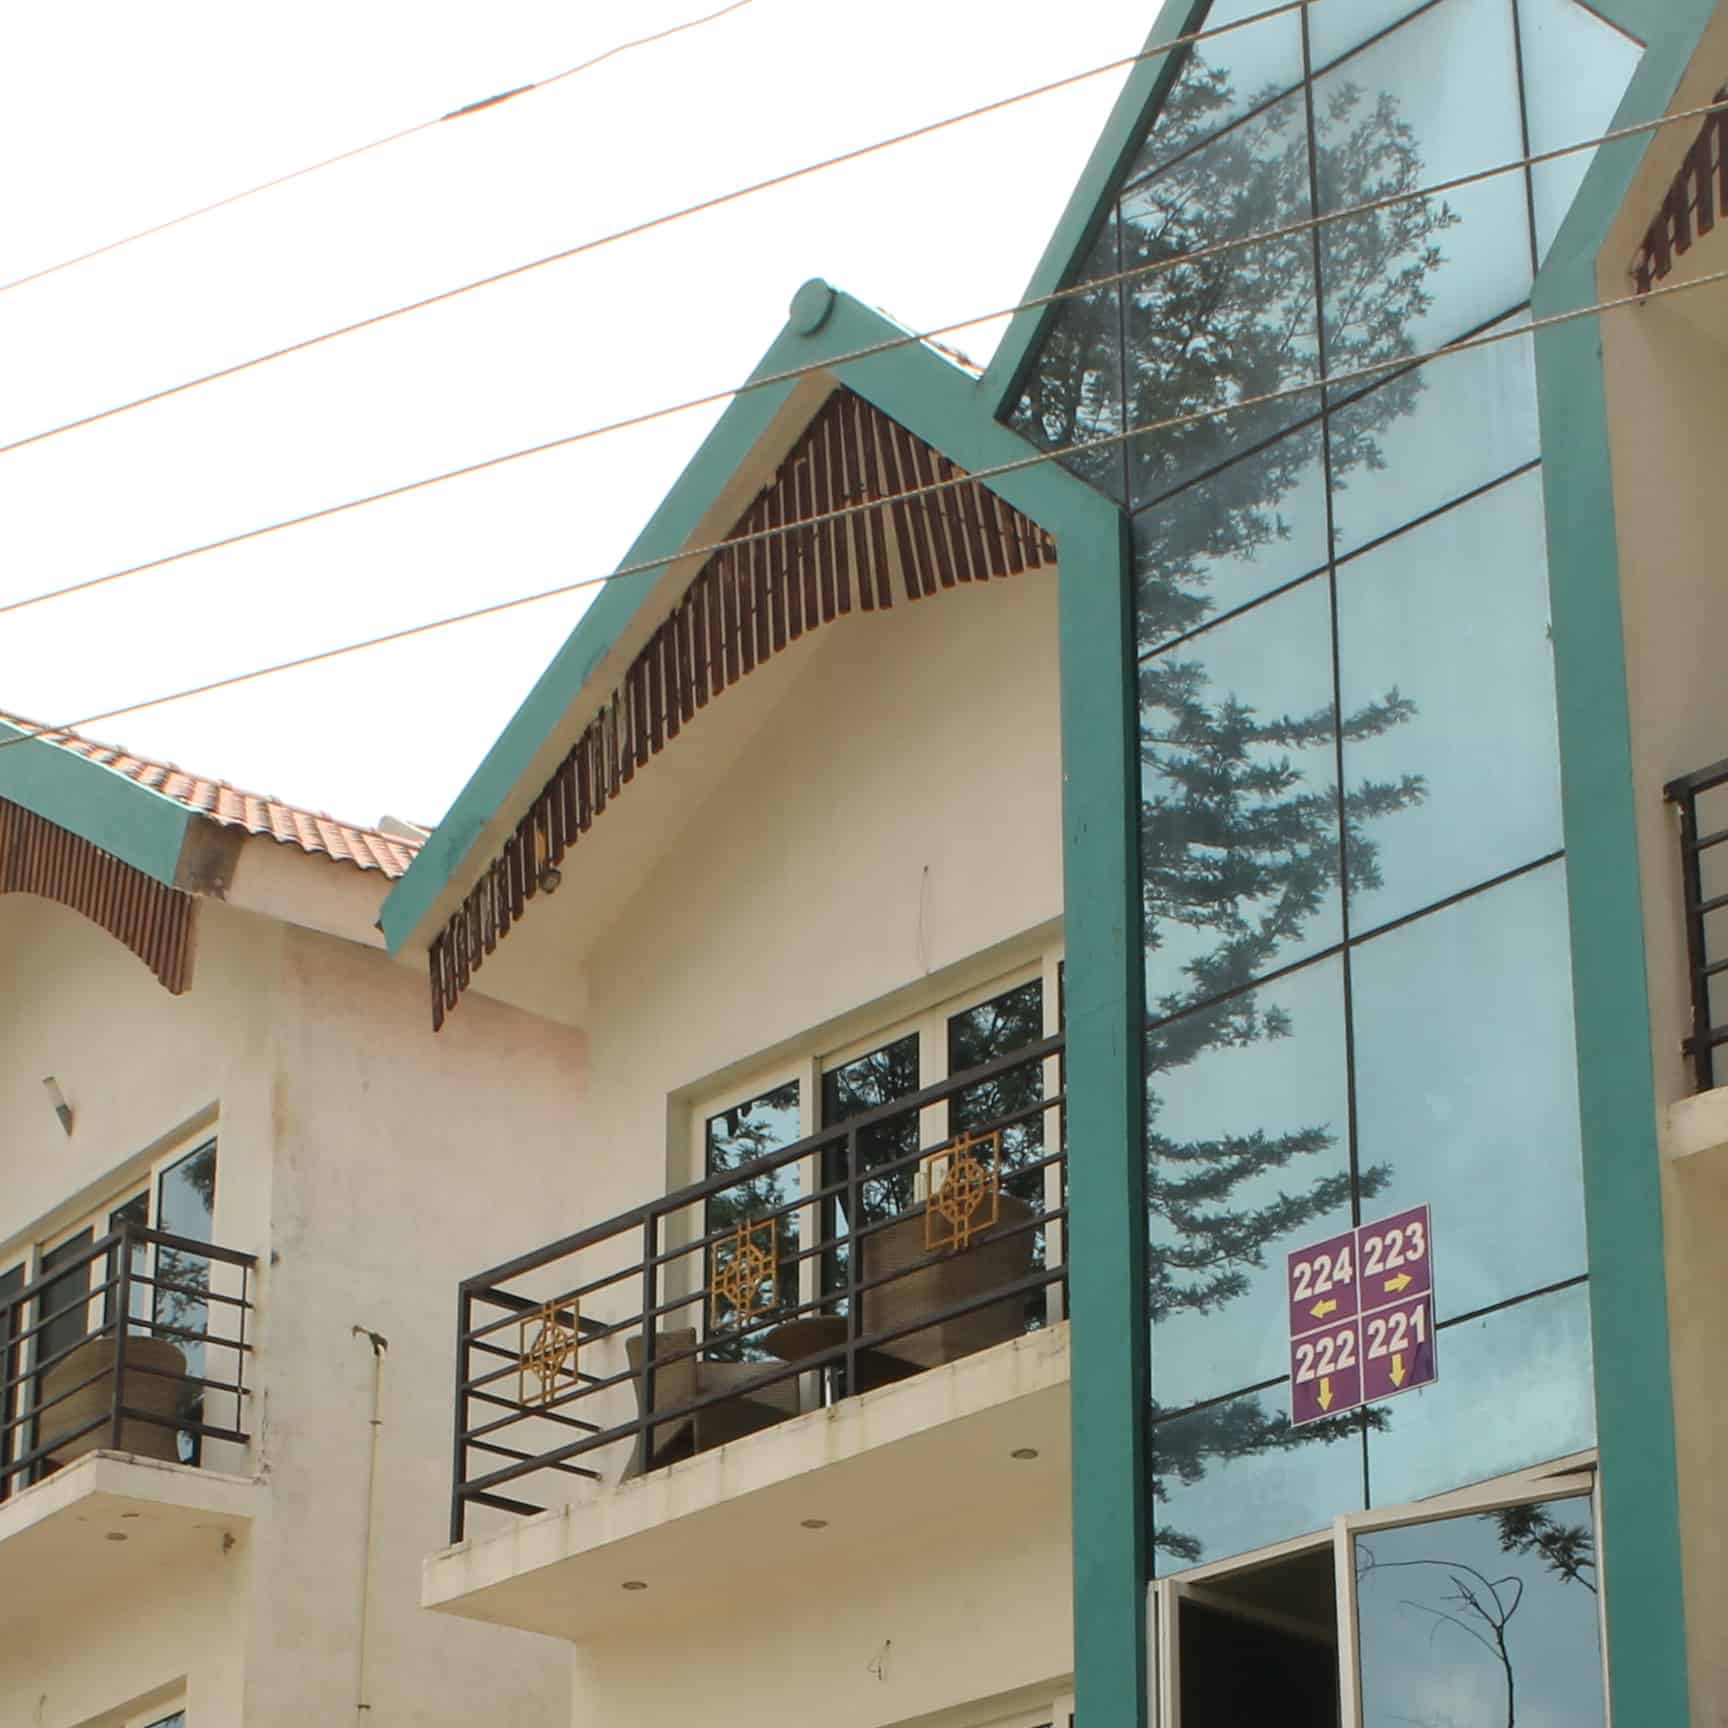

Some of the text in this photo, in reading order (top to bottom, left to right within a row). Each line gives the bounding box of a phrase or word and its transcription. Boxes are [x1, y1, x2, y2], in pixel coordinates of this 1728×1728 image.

[1293, 1222, 1425, 1302] 224 223
[1295, 1304, 1425, 1384] 222 221
